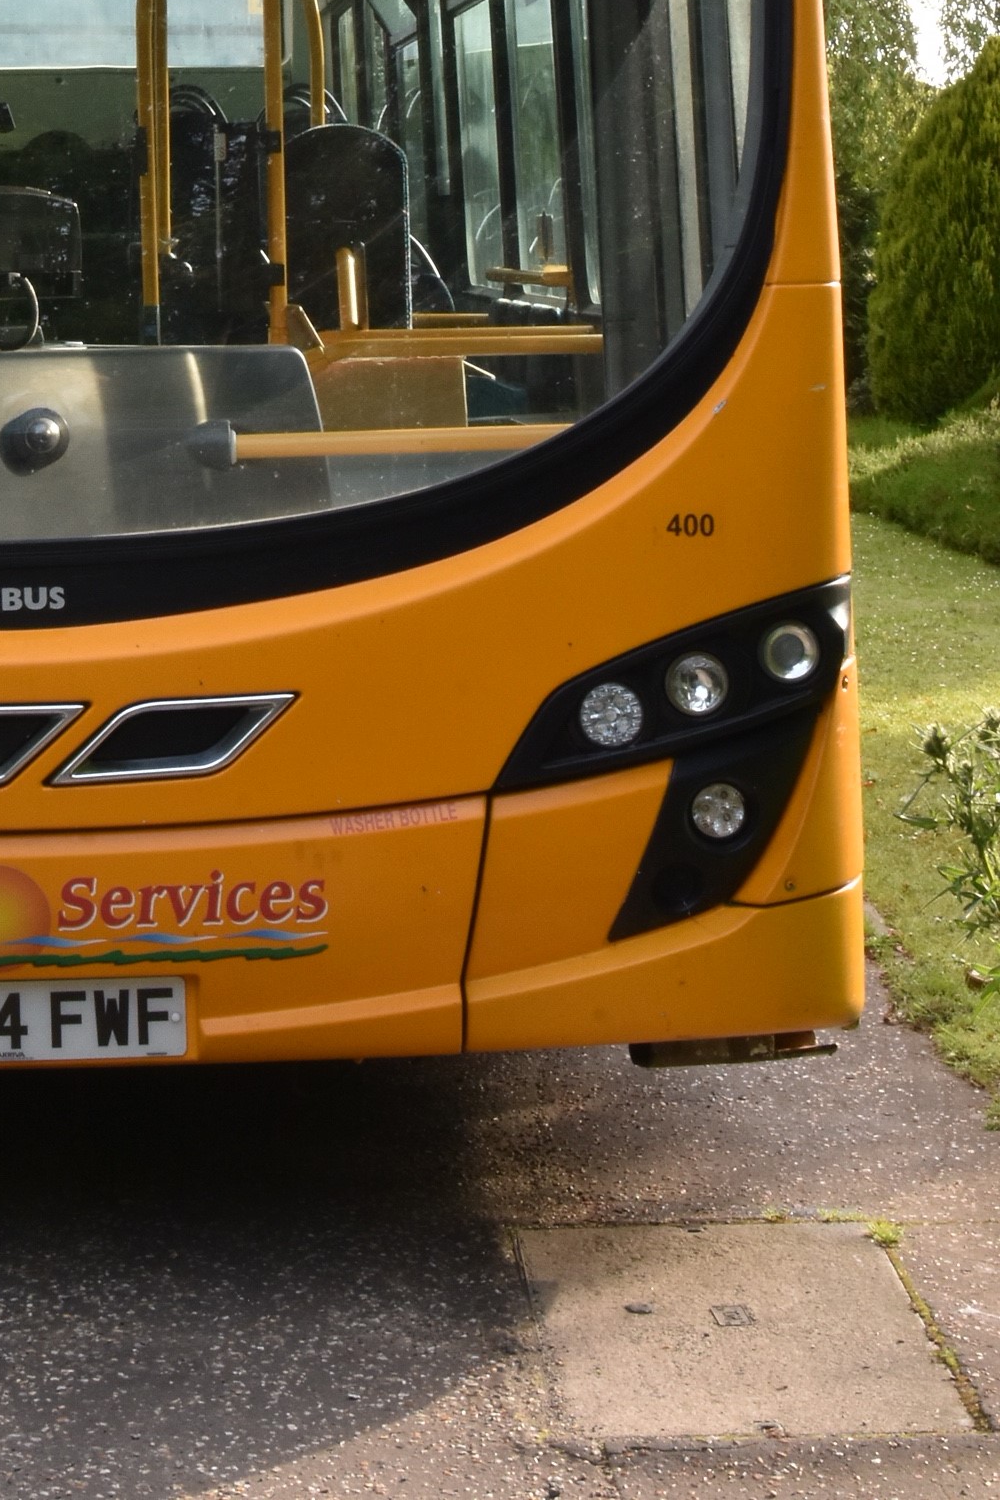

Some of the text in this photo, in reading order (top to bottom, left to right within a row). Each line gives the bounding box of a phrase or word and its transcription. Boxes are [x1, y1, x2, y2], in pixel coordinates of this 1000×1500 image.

[666, 513, 715, 537] 400
[1, 586, 66, 611] BUS
[329, 802, 459, 836] WASHER BOTTLE
[56, 870, 329, 932] Services
[49, 987, 174, 1049] FWF
